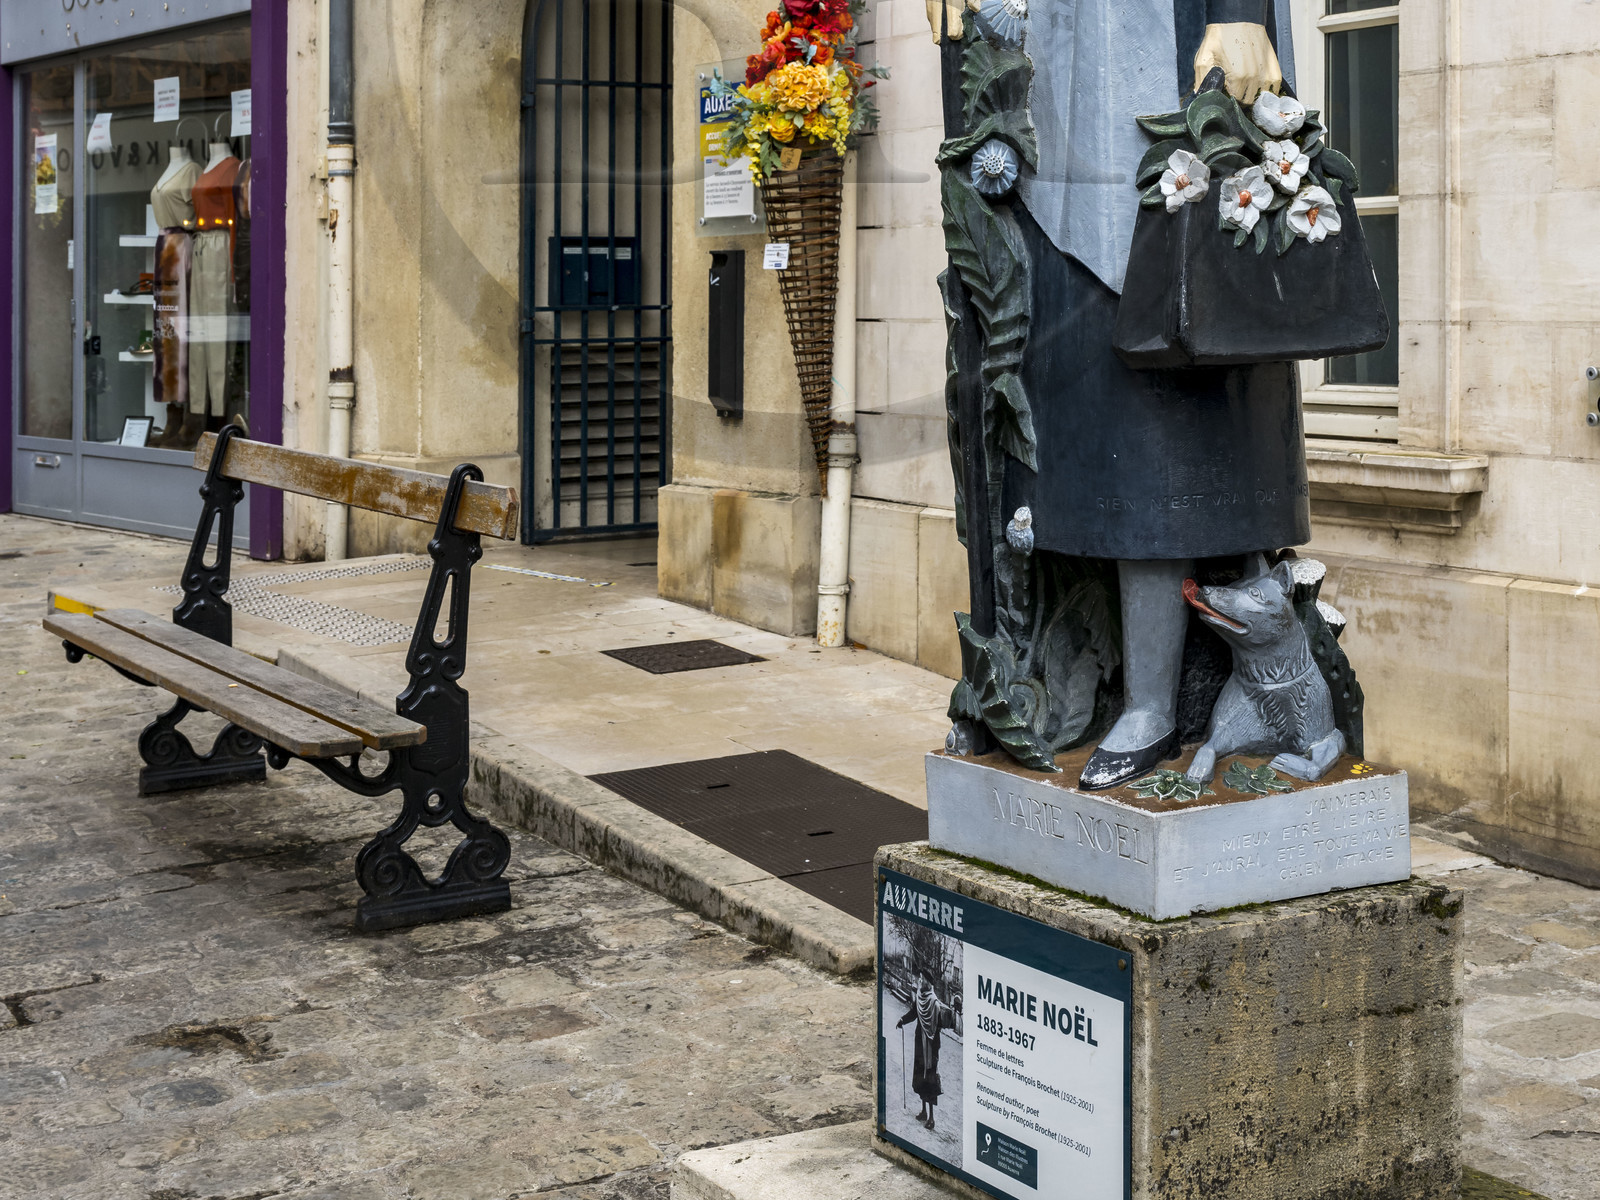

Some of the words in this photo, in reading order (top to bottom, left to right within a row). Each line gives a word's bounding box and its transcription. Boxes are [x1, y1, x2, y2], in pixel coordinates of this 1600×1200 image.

[704, 93, 736, 115] AUXE
[1150, 494, 1204, 510] N'EST
[1211, 492, 1246, 506] VRAI
[1255, 488, 1281, 505] QUE
[1304, 786, 1392, 817] J'AIMERAIS
[992, 787, 1065, 841] MARIE
[1074, 811, 1149, 866] NOËL
[1221, 830, 1271, 854] MIEUX
[1282, 820, 1321, 842] ETRE
[1173, 866, 1194, 884] ET
[1202, 853, 1261, 878] J'AURAI
[1277, 843, 1307, 863] ETE
[1313, 832, 1359, 855] TOUTE
[1361, 829, 1382, 845] MA
[1385, 823, 1408, 839] VIE
[1279, 861, 1323, 881] CHIEN
[1335, 846, 1395, 871] ATTACHE
[882, 880, 965, 934] AUXERRE
[977, 974, 1037, 1023] MARIE
[1043, 1000, 1099, 1047] NOËL
[976, 1013, 1036, 1051] 1883-1967
[976, 1039, 997, 1056] Femme
[997, 1048, 1006, 1059] de
[1005, 1051, 1025, 1068] lettres
[976, 1053, 1003, 1074] Sculpture
[1003, 1064, 1012, 1076] de
[1011, 1069, 1036, 1088] François
[1036, 1079, 1060, 1098] Brochet
[1060, 1090, 1095, 1115] (1925-2001)
[976, 1081, 1005, 1101] Renowned
[1004, 1096, 1026, 1113] author,
[1025, 1105, 1040, 1119] poet
[976, 1095, 1003, 1116] Sculpture
[1002, 1106, 1011, 1120] by
[1010, 1111, 1035, 1129] François
[1034, 1122, 1058, 1140] Brochet
[1057, 1132, 1092, 1158] (1925-2001)
